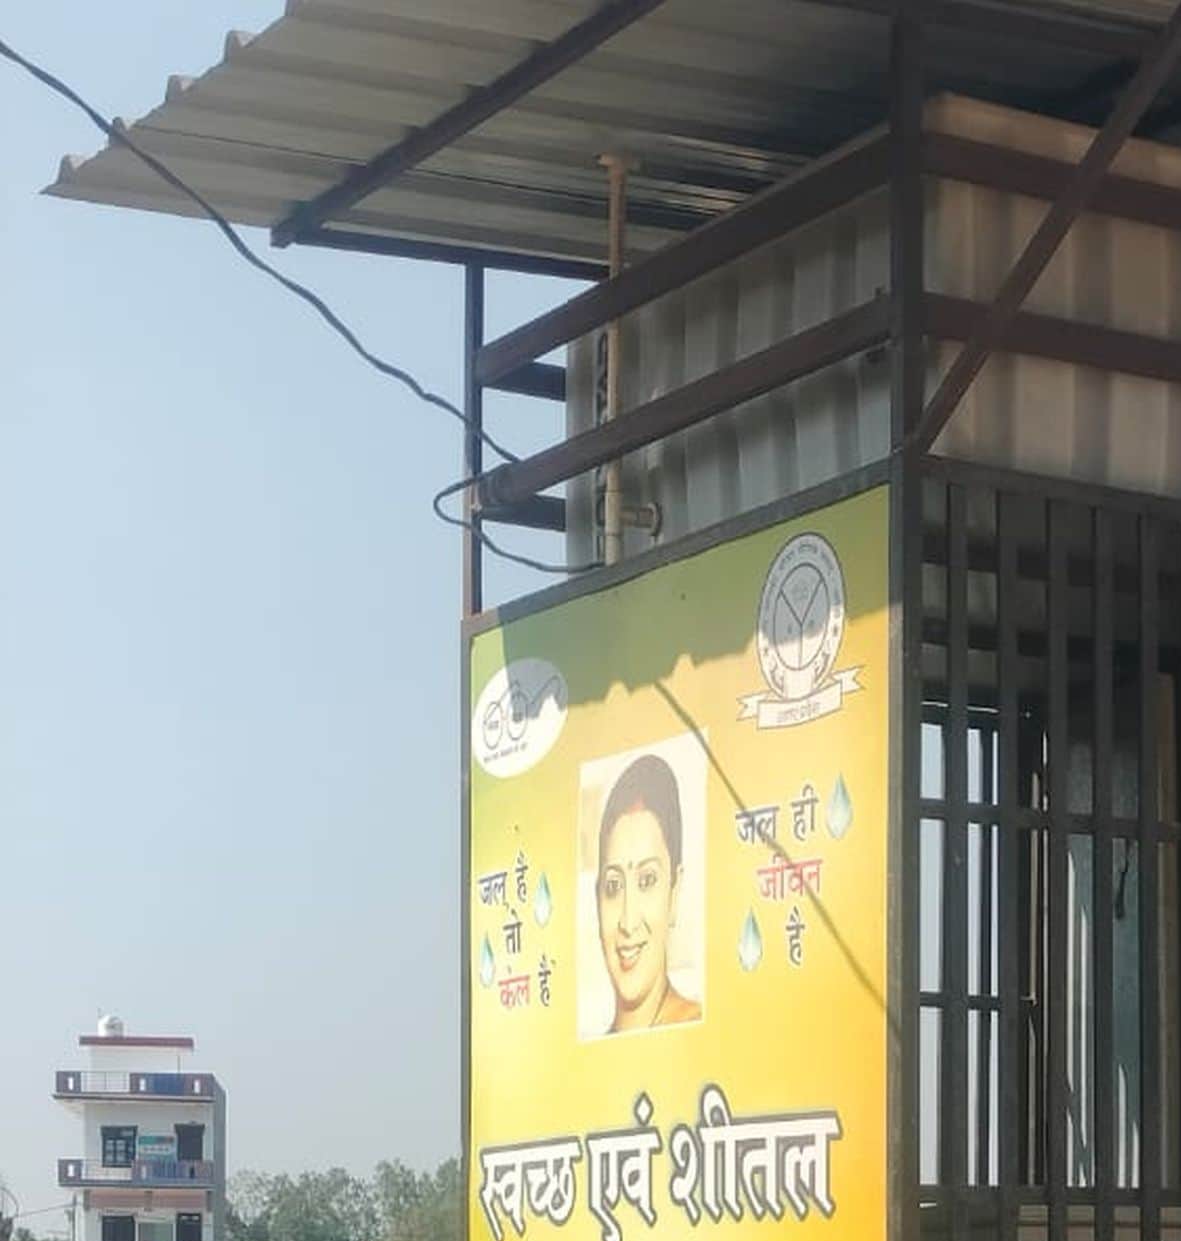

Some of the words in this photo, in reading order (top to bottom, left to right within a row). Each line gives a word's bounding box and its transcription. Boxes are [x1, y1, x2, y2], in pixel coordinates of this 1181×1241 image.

[735, 806, 780, 844] जल
[791, 784, 819, 841] ही
[478, 872, 508, 906] जल
[757, 852, 823, 900] जीवन
[502, 908, 522, 954] तो
[786, 906, 805, 966] है
[669, 1083, 843, 1227] शीतल
